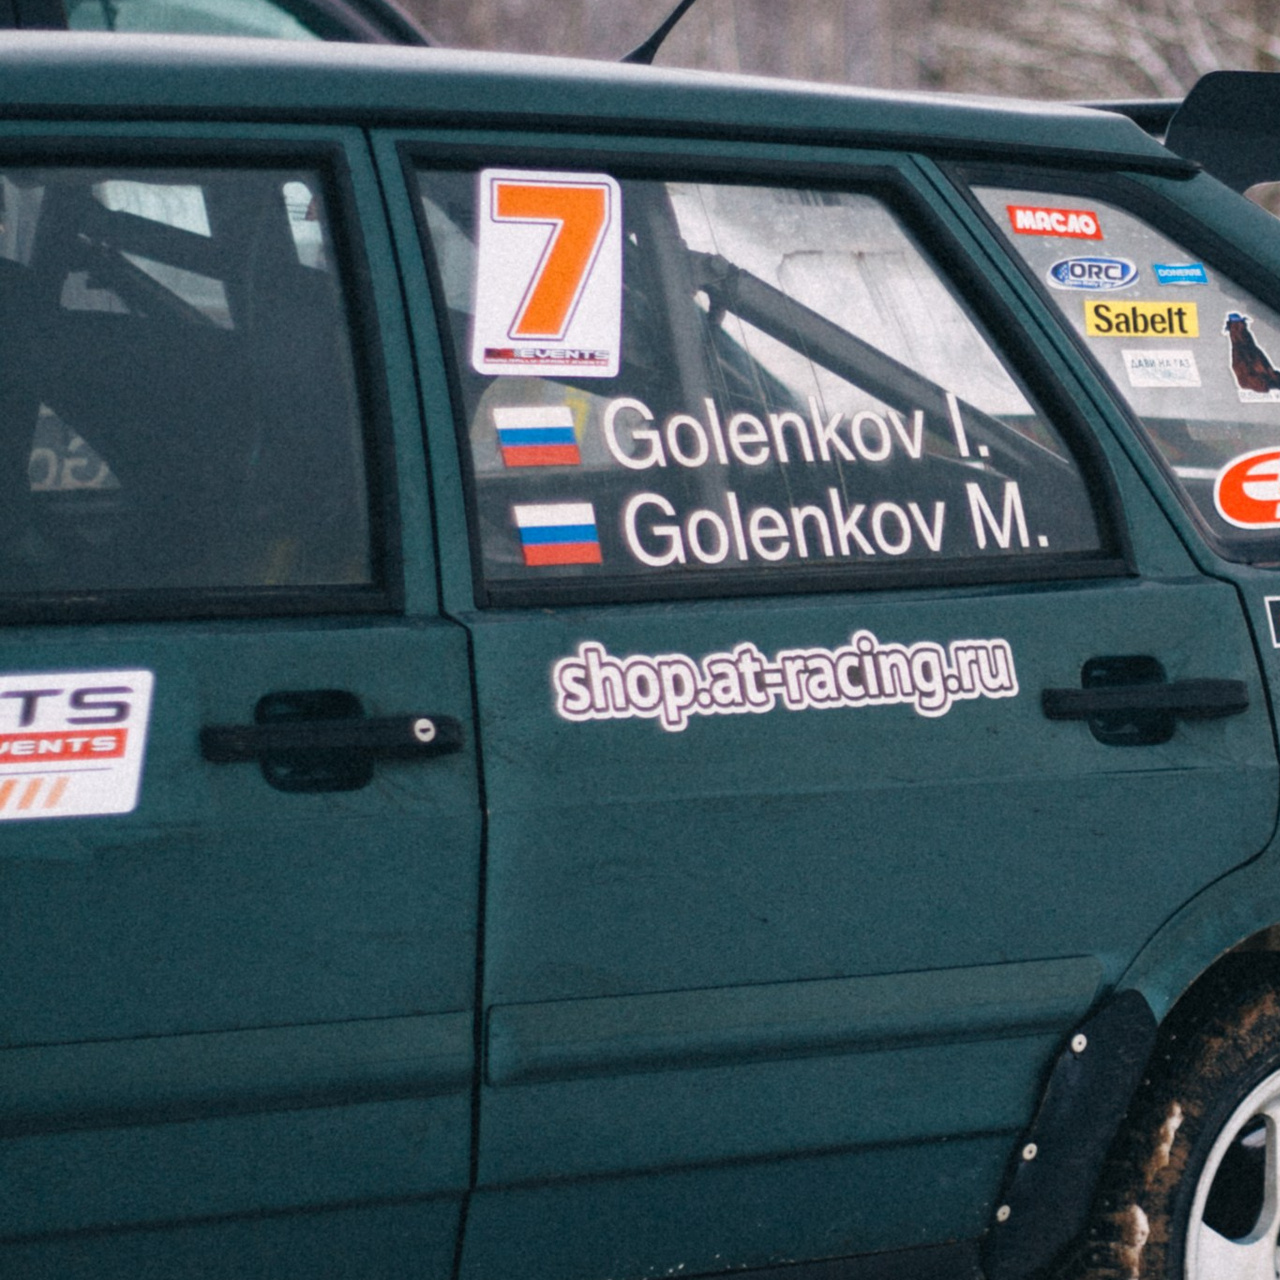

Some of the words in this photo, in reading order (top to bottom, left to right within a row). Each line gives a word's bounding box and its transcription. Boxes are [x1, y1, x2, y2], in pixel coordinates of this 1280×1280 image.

[491, 179, 612, 340] 7
[1070, 263, 1121, 280] ORC
[520, 348, 609, 359] EVENTS
[1094, 304, 1188, 334] Sabelt
[603, 396, 923, 470] Golenkov
[945, 392, 990, 458] I.
[624, 487, 945, 567] Golenkov
[965, 481, 1049, 550] M.
[557, 633, 1016, 727] shop.at-racing.ru
